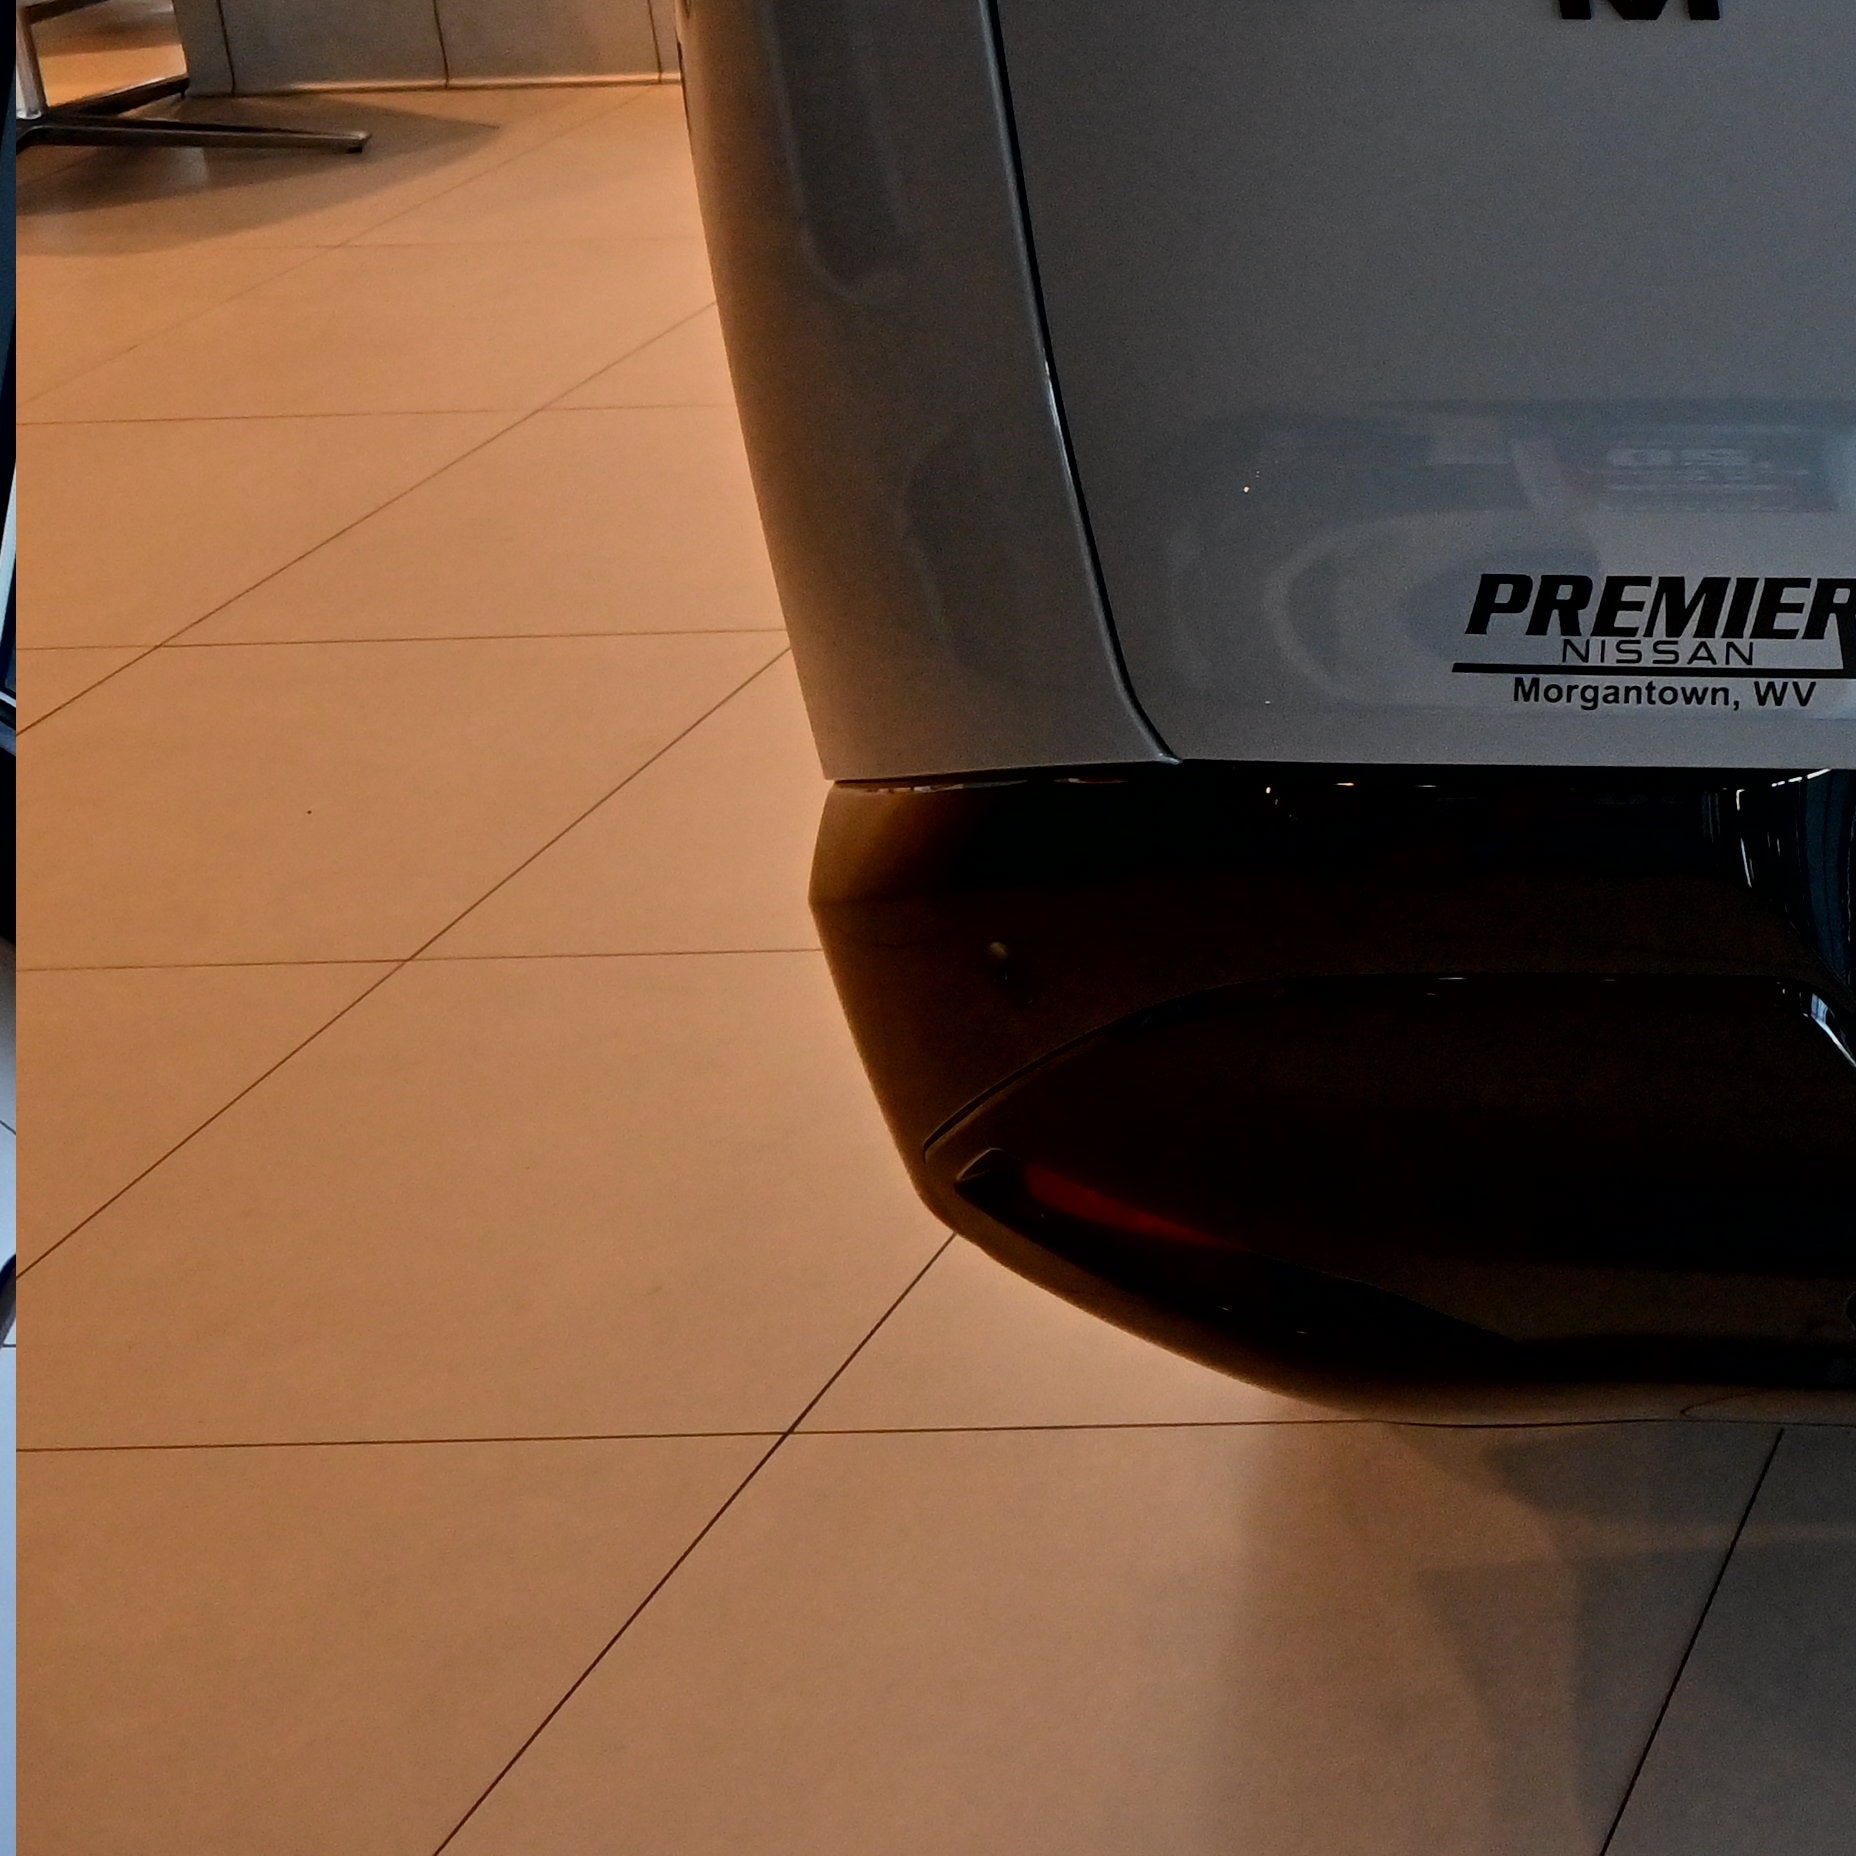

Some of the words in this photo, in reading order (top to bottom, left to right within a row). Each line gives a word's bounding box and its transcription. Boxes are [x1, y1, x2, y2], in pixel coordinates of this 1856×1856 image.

[1560, 638, 1755, 667] NISSAN
[1511, 676, 1741, 711] Morgantown,
[1753, 680, 1818, 708] WV
